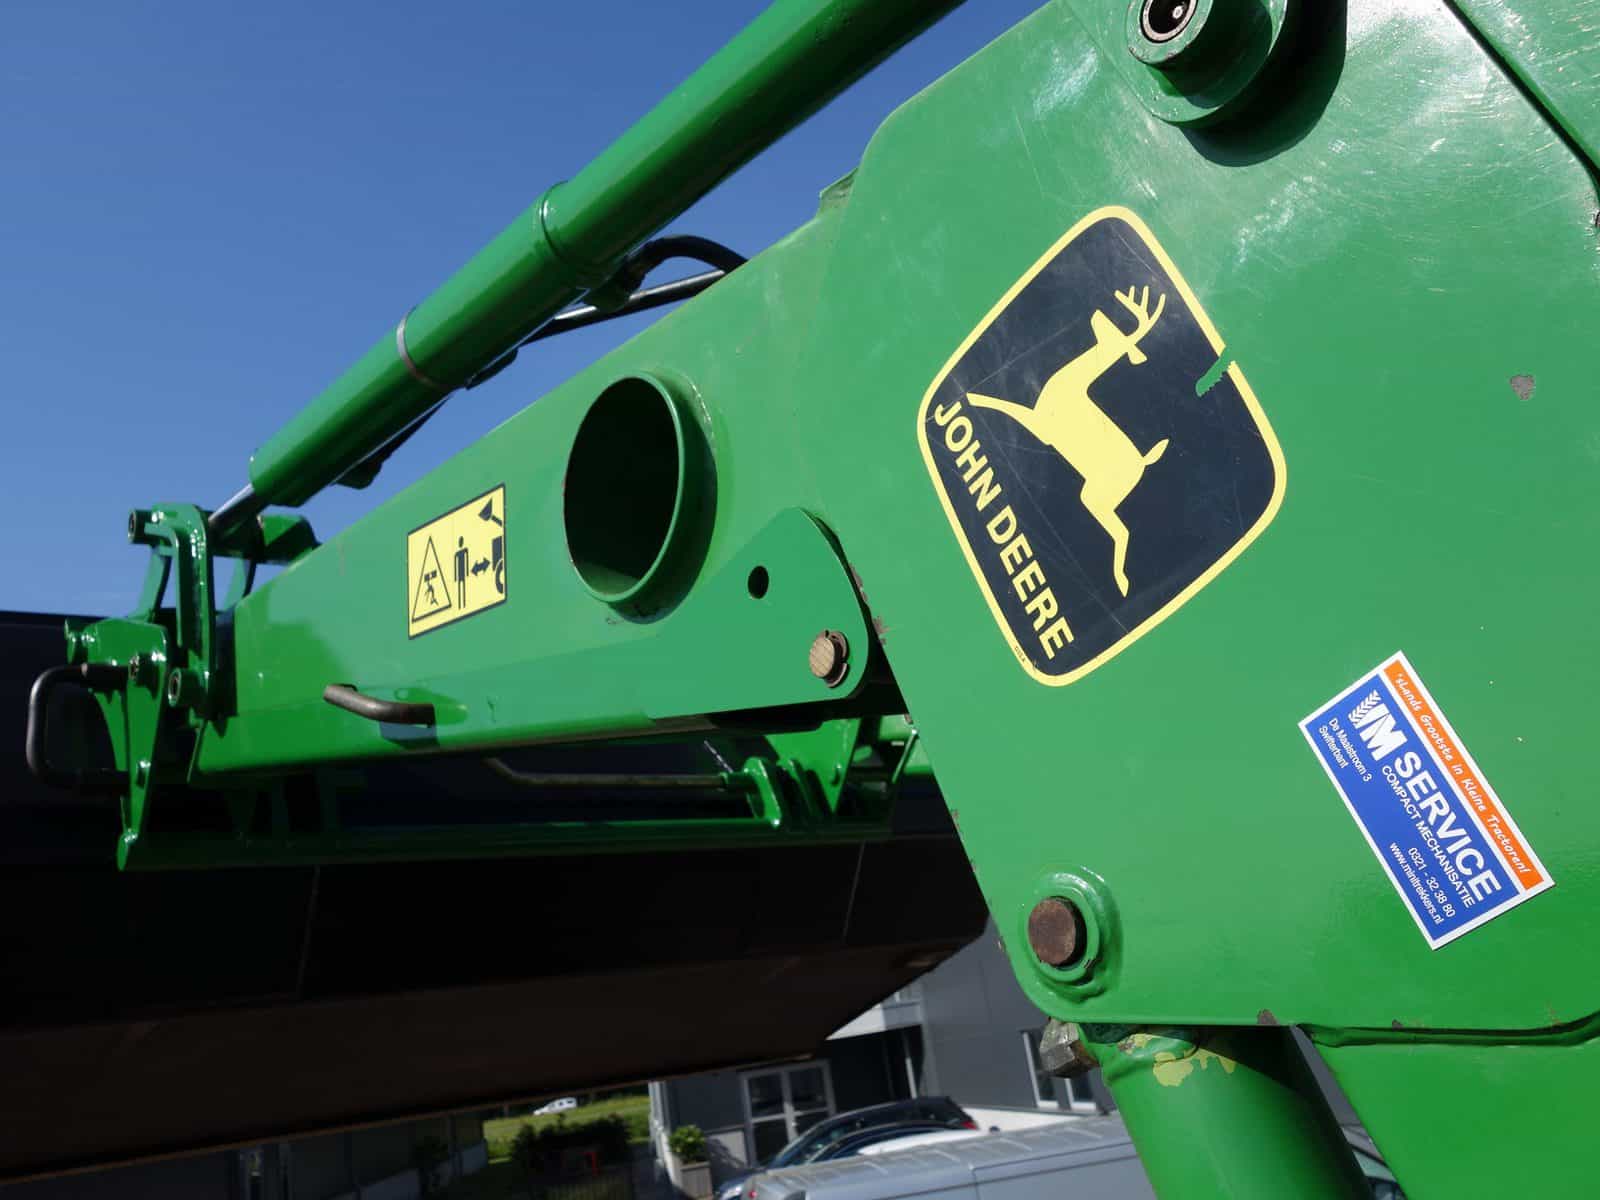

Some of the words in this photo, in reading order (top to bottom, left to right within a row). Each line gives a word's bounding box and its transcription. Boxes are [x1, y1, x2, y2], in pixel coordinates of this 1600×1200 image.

[934, 401, 1002, 512] JOHN
[986, 505, 1074, 660] DEERE
[1319, 725, 1349, 768] Swifterbant
[1329, 717, 1339, 731] De
[1362, 772, 1372, 782] 3
[1420, 714, 1453, 761] Grootste
[1452, 763, 1464, 775] in
[1461, 778, 1487, 812] Kleine
[1487, 814, 1531, 873] Tractoren!
[1382, 765, 1421, 820] COMPACT
[1415, 820, 1476, 908] MECHANISATIE
[1394, 751, 1502, 901] SERVICE
[1408, 847, 1427, 870] 0321
[1426, 876, 1439, 891] 32
[1434, 890, 1447, 904] 38
[1442, 903, 1456, 917] 80
[1389, 842, 1444, 924] www.minitrekkers.nl
